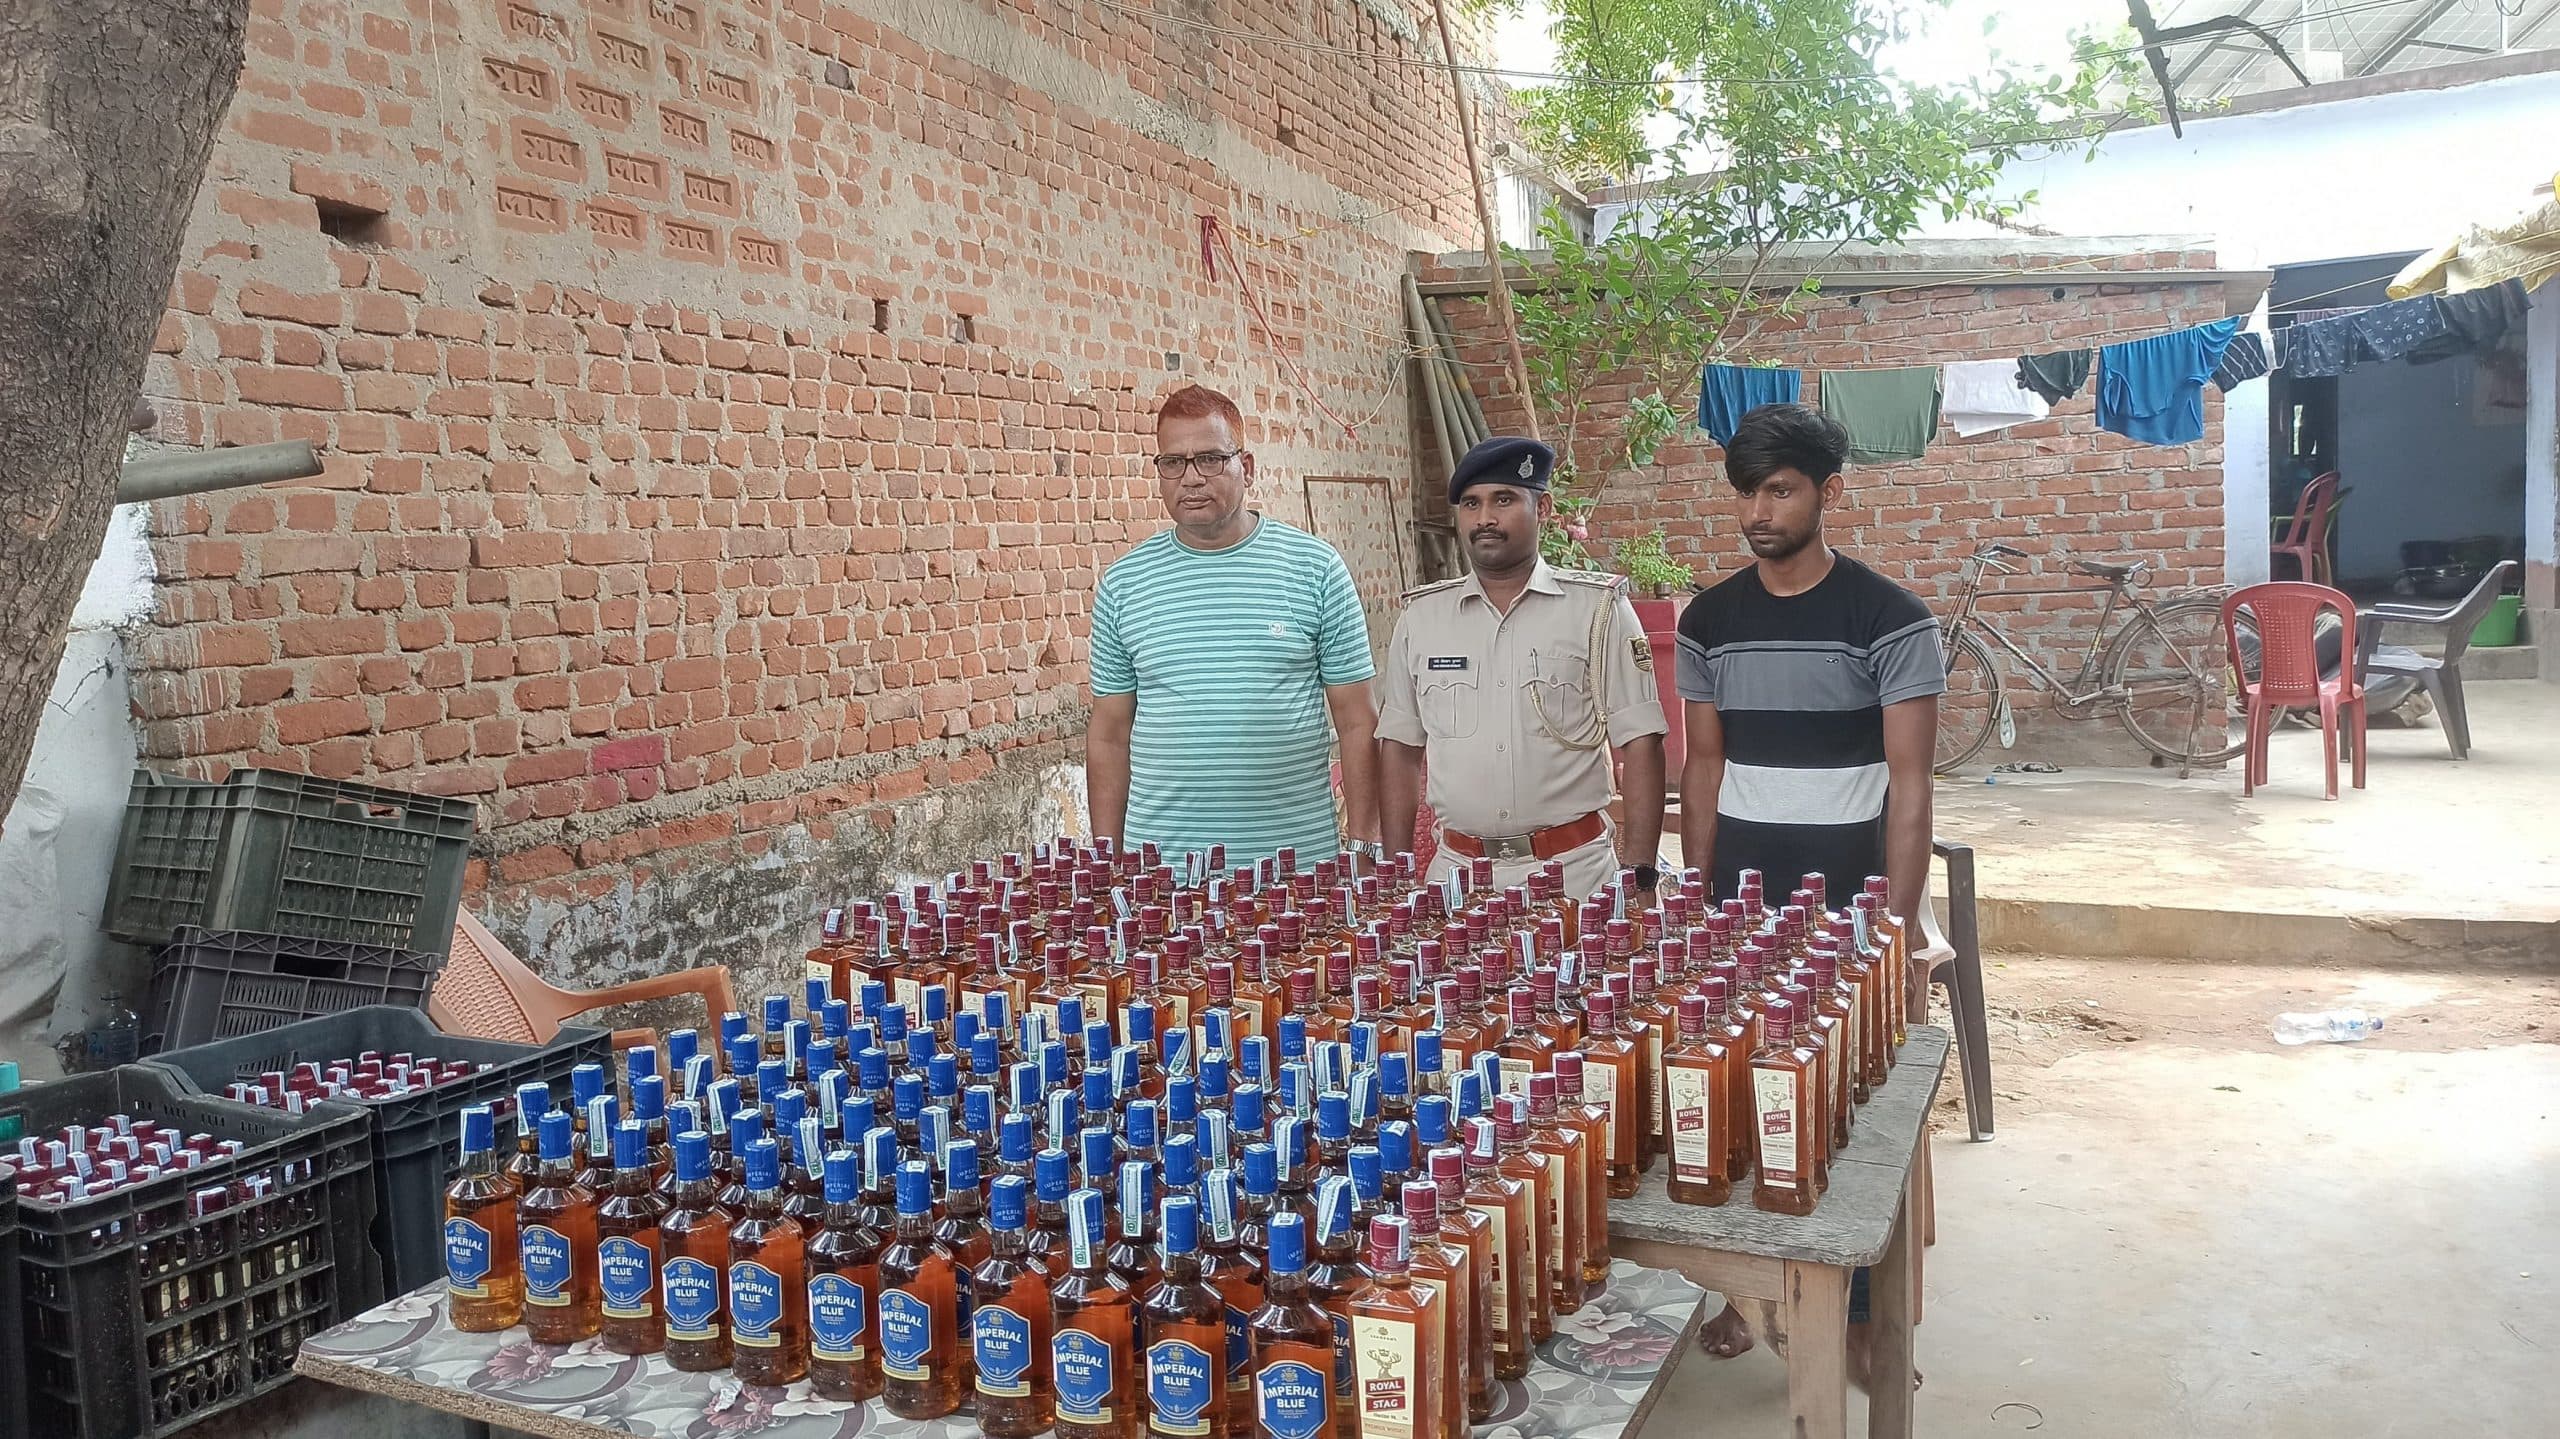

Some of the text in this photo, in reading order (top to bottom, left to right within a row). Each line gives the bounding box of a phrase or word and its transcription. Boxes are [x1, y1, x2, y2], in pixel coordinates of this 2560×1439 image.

[1679, 1109, 1701, 1118] ROYAL
[1766, 1113, 1789, 1122] ROYAL
[1681, 1121, 1699, 1130] STAG
[1768, 1125, 1787, 1134] STAG
[451, 1247, 472, 1257] BLUE
[530, 1255, 551, 1265] BLUE
[602, 1255, 645, 1269] IMPERIAL
[610, 1267, 633, 1276] BLUE
[666, 1277, 711, 1290] IMPERIAL
[731, 1281, 774, 1297] IMPERIAL
[675, 1287, 698, 1298] BLUE
[739, 1293, 762, 1304] BLUE
[812, 1295, 857, 1309] IMPERIAL
[820, 1306, 844, 1316] BLUE
[881, 1311, 923, 1328] IMPERIAL
[888, 1323, 910, 1333] BLUE
[976, 1328, 1023, 1343] IMPERIAL
[985, 1339, 1010, 1350] BLUE
[1056, 1352, 1104, 1368] IMPERIAL
[1064, 1364, 1091, 1376] BLUE
[1152, 1363, 1204, 1379] IMPERIAL
[1163, 1375, 1190, 1386] BLUE
[1369, 1380, 1402, 1392] ROYAL
[1264, 1385, 1319, 1399] IMPERIAL
[1276, 1398, 1306, 1409] BLUE
[1372, 1398, 1399, 1409] STAG
